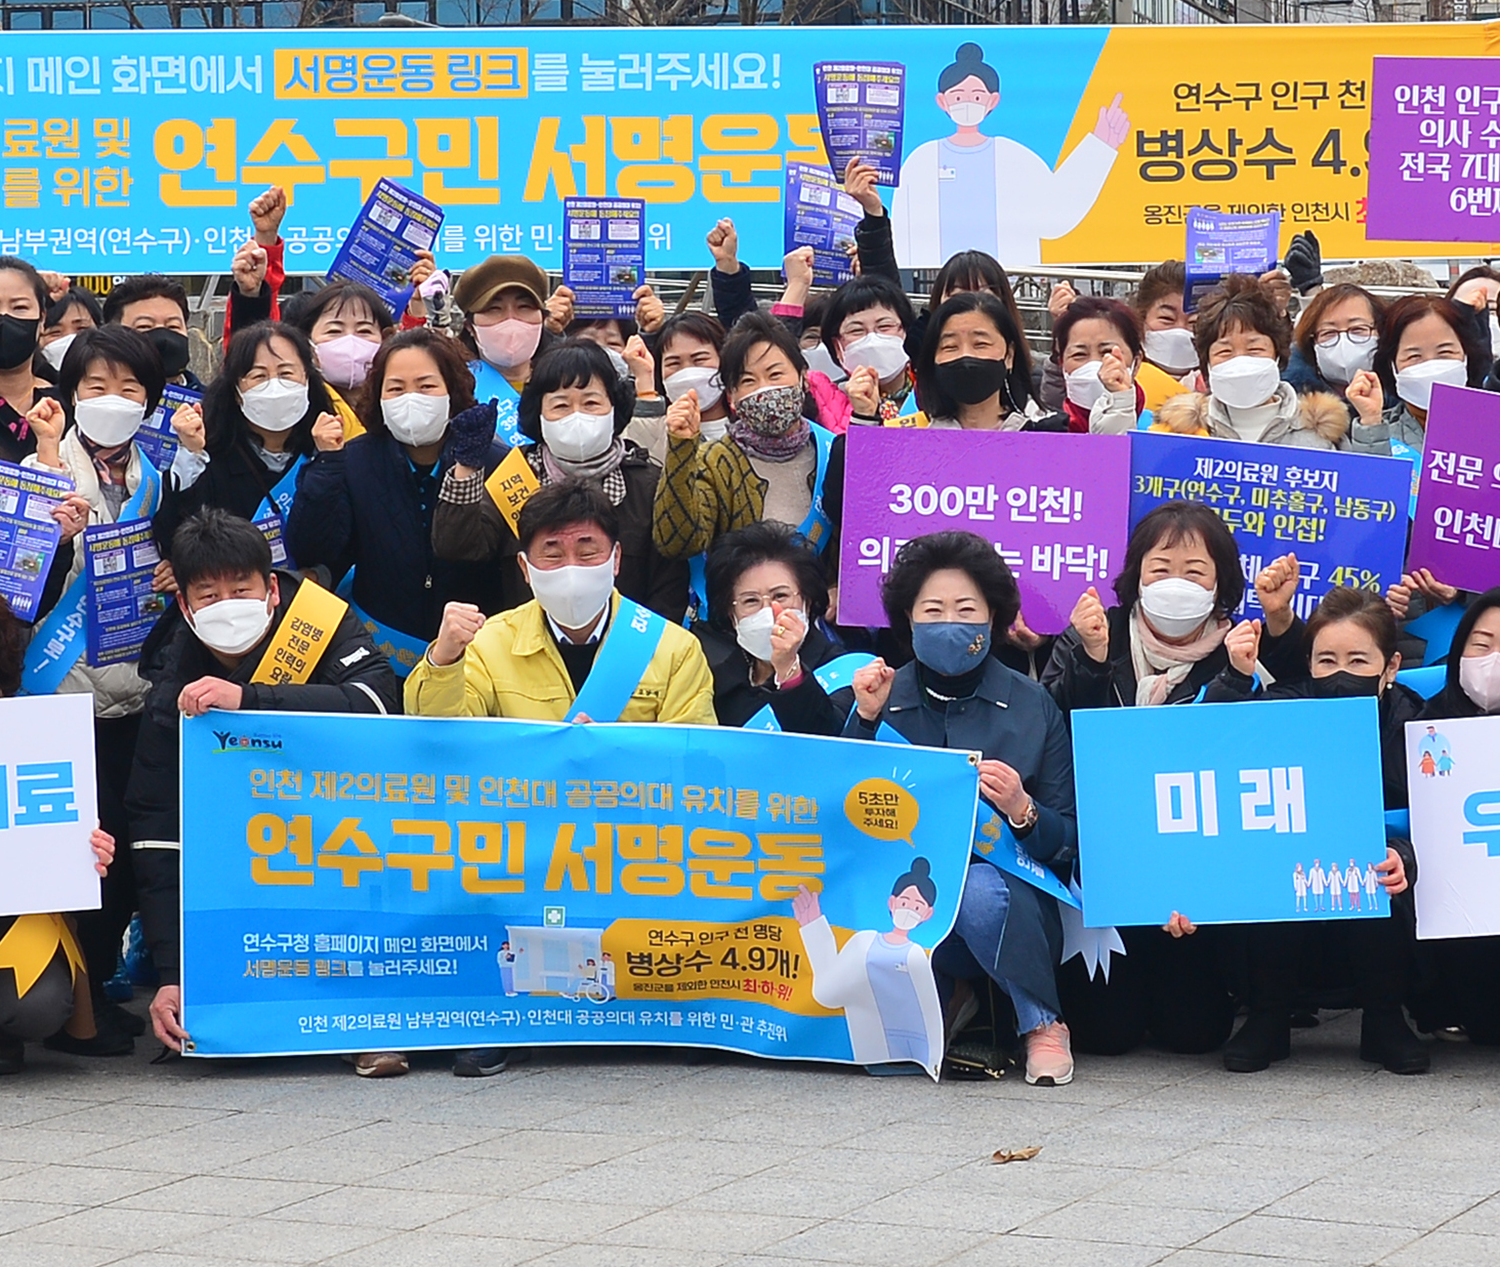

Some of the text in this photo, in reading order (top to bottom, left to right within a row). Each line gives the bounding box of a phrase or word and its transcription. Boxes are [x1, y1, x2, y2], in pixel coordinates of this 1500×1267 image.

[26, 56, 102, 95] 메인
[112, 55, 263, 95] 화면에서
[285, 54, 436, 94] 서명운동
[579, 54, 780, 94] 눌러주세요!
[1173, 78, 1367, 113] 연수구 인구 천
[1394, 85, 1444, 116] 인천
[93, 117, 132, 159] 및
[1419, 117, 1470, 149] 의사
[152, 117, 499, 206] 연수구민
[1136, 127, 1294, 181] 병상수
[1399, 153, 1451, 183] 전국
[1461, 152, 1500, 182] 7대
[52, 167, 133, 207] 위한
[1290, 200, 1351, 224] 인천시
[472, 224, 523, 253] 위한
[499, 472, 523, 494] 지역
[1194, 458, 1339, 492] 제2의료원 후보지
[1429, 449, 1483, 489] 전문
[506, 484, 531, 509] 보건
[889, 485, 1083, 523] 300만 인천!
[1134, 475, 1396, 522] 3개구(연수구, 미추홀구, 남동구)
[1273, 514, 1327, 543] 인접!
[1032, 544, 1108, 581] 바닥!
[1328, 566, 1381, 593] 45%
[290, 615, 325, 639] 감염병
[275, 645, 307, 675] 인력의
[288, 635, 311, 655] 전문
[212, 730, 282, 750] Yeonsu
[250, 769, 819, 824] 인천 제2의료원 및 인천대 공공의대 유치를 위한
[858, 790, 901, 807] 5초만
[862, 817, 899, 831] 주세요!
[246, 812, 825, 901] 연수구민 서명운동
[243, 932, 488, 955] 연수구청 홈페이지 메인 화면에서
[648, 923, 783, 947] 연수구 명당
[243, 957, 458, 978] 서명운동 눌러주세요!
[626, 947, 800, 979] 병상수 4.9개!
[676, 979, 708, 992] 제외한
[709, 978, 741, 991] 인천시
[298, 1008, 788, 1043] 인천 제2의료원 공공의대 유치를 위한 추진위
